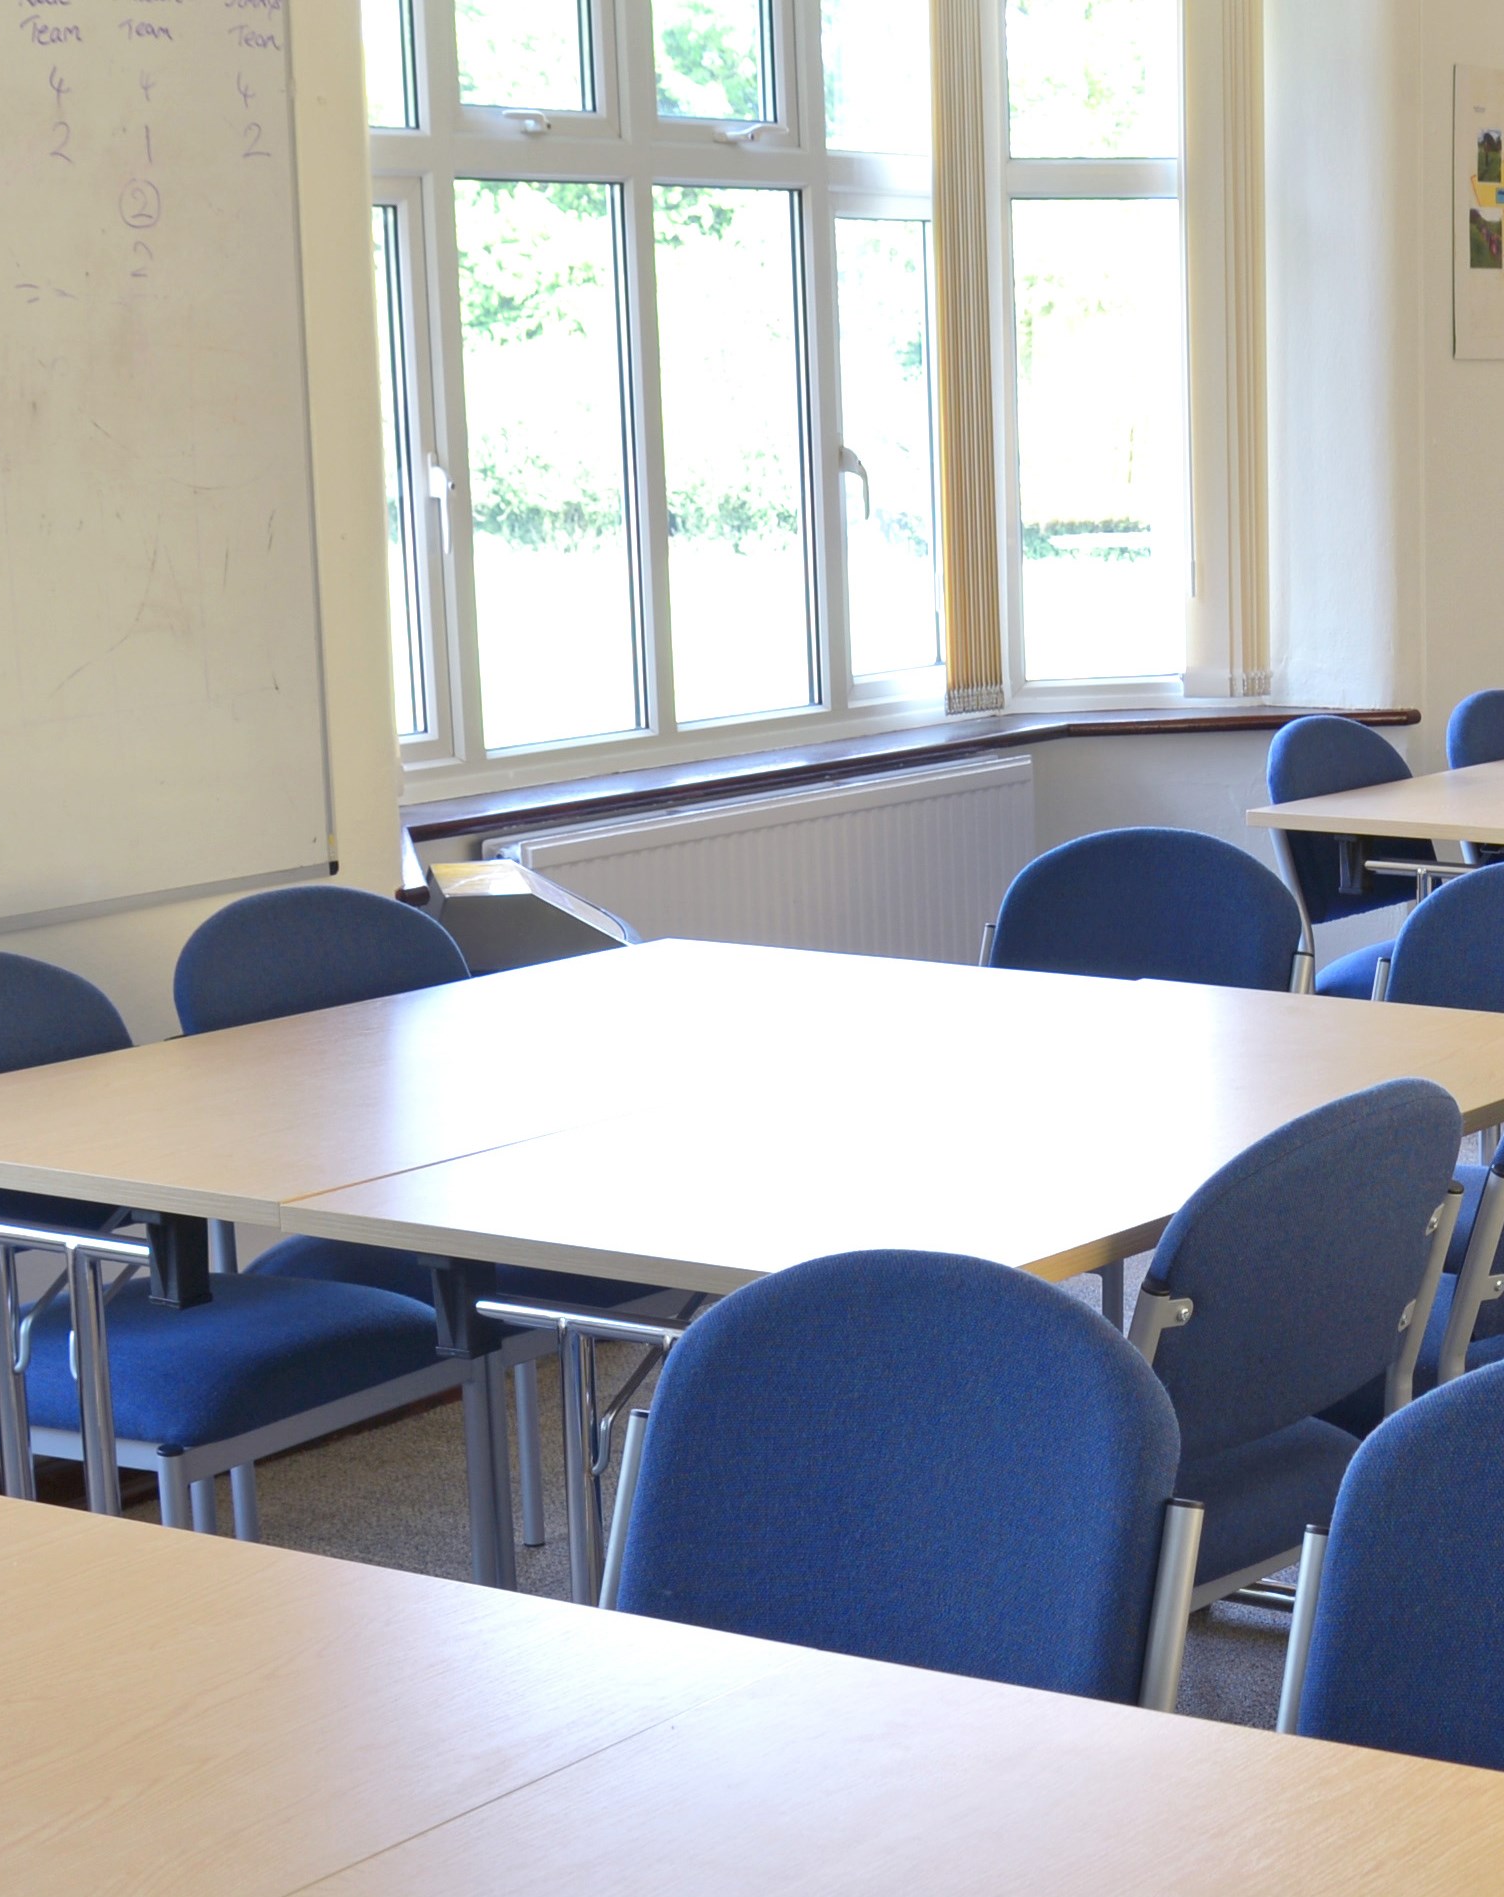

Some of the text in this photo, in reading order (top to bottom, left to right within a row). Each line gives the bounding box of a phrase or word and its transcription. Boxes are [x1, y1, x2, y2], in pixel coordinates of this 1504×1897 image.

[20, 15, 82, 45] Team
[119, 18, 173, 41] Team
[49, 66, 70, 107] 4
[139, 70, 155, 101] 4
[237, 72, 255, 108] 4
[50, 121, 72, 163] 2
[242, 122, 271, 157] 2
